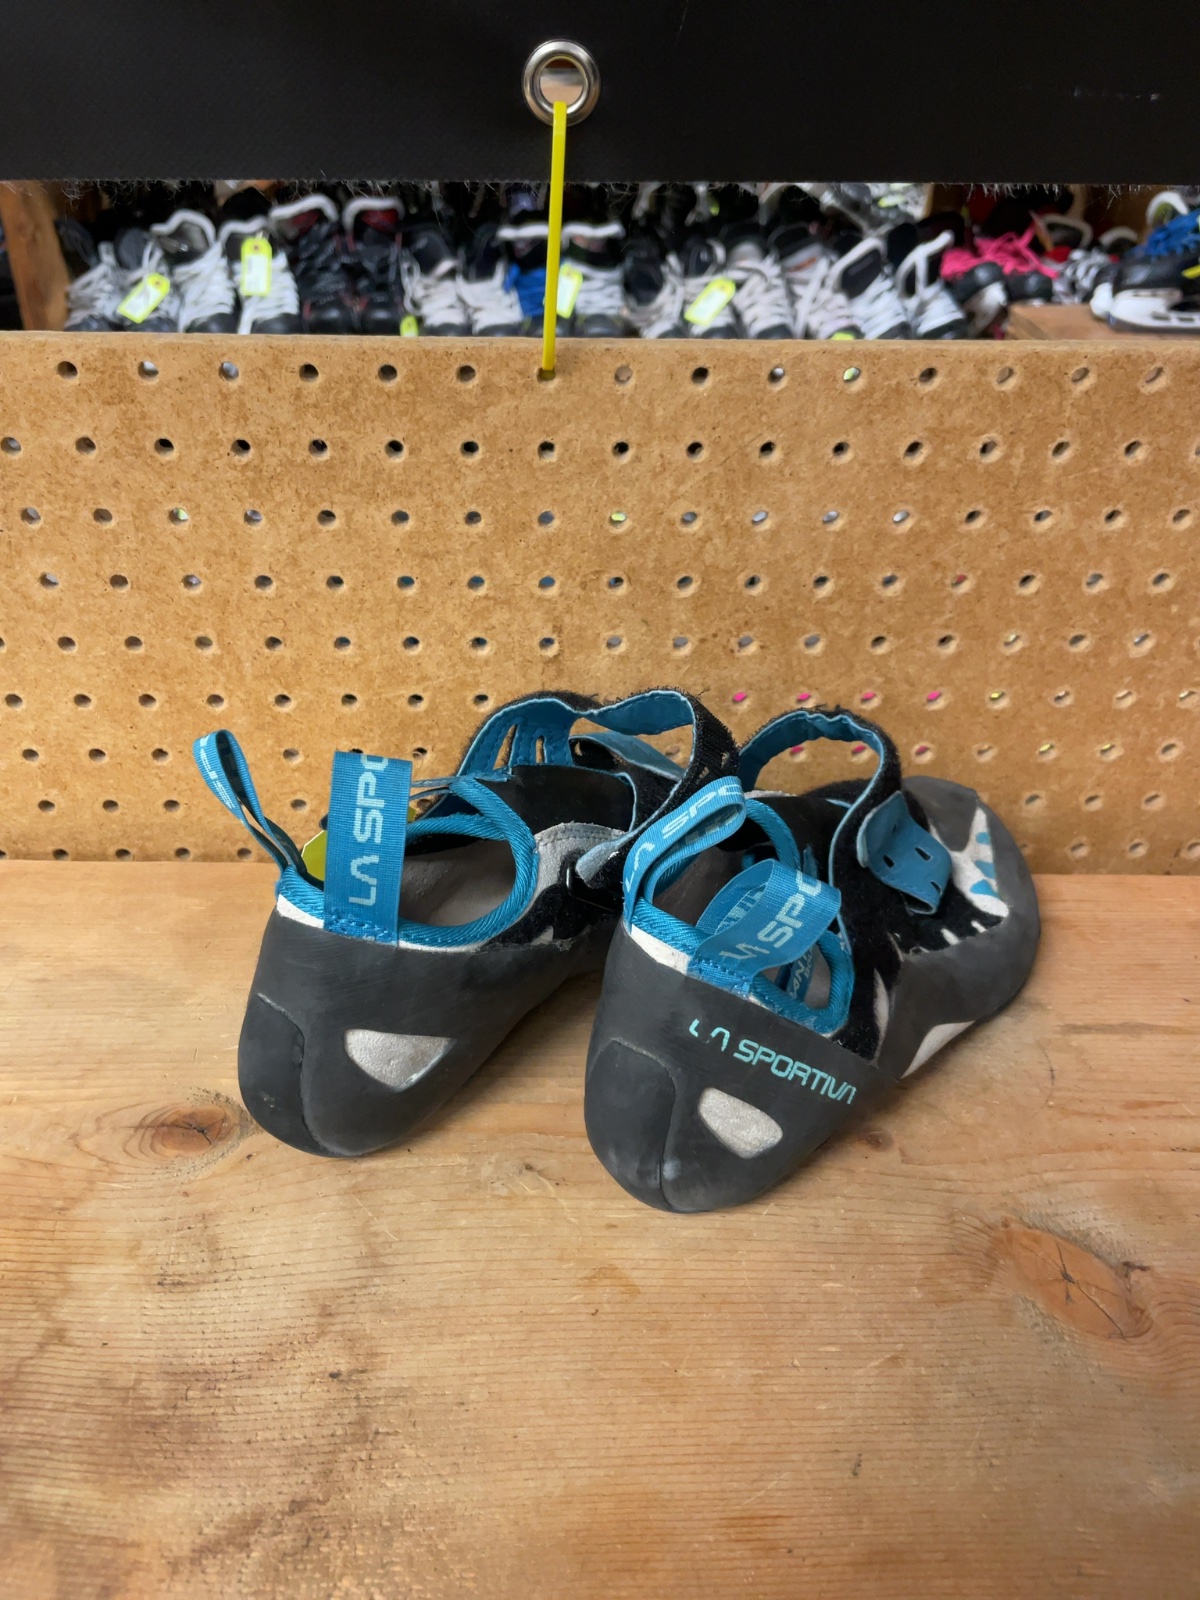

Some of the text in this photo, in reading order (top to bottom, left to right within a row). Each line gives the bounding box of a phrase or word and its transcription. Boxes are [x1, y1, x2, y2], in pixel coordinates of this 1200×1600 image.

[349, 854, 379, 906] LA
[689, 1018, 857, 1105] LA SPORTIVA
